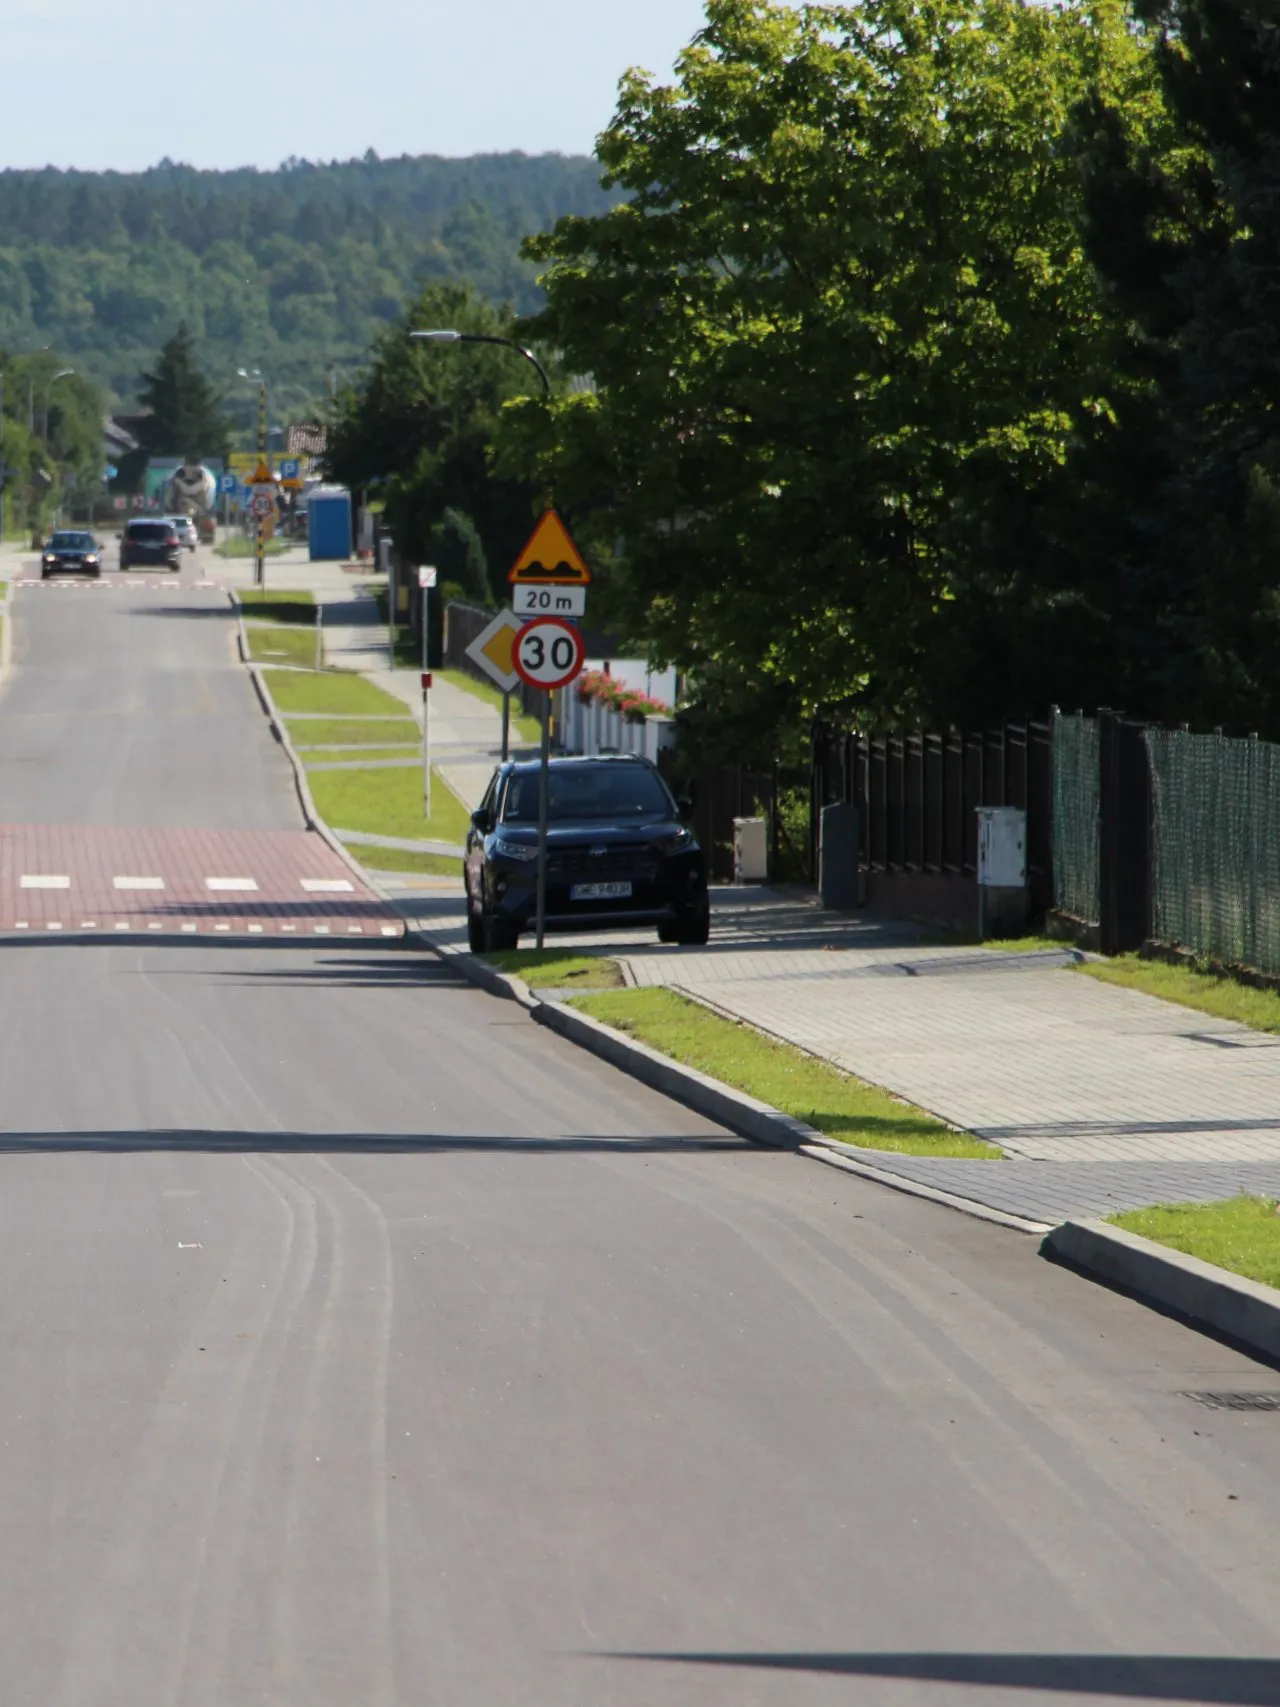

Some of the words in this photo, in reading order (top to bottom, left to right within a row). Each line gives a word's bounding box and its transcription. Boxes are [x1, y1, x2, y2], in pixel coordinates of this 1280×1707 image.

[526, 591, 551, 609] 20
[555, 597, 572, 610] m
[522, 635, 574, 671] 30
